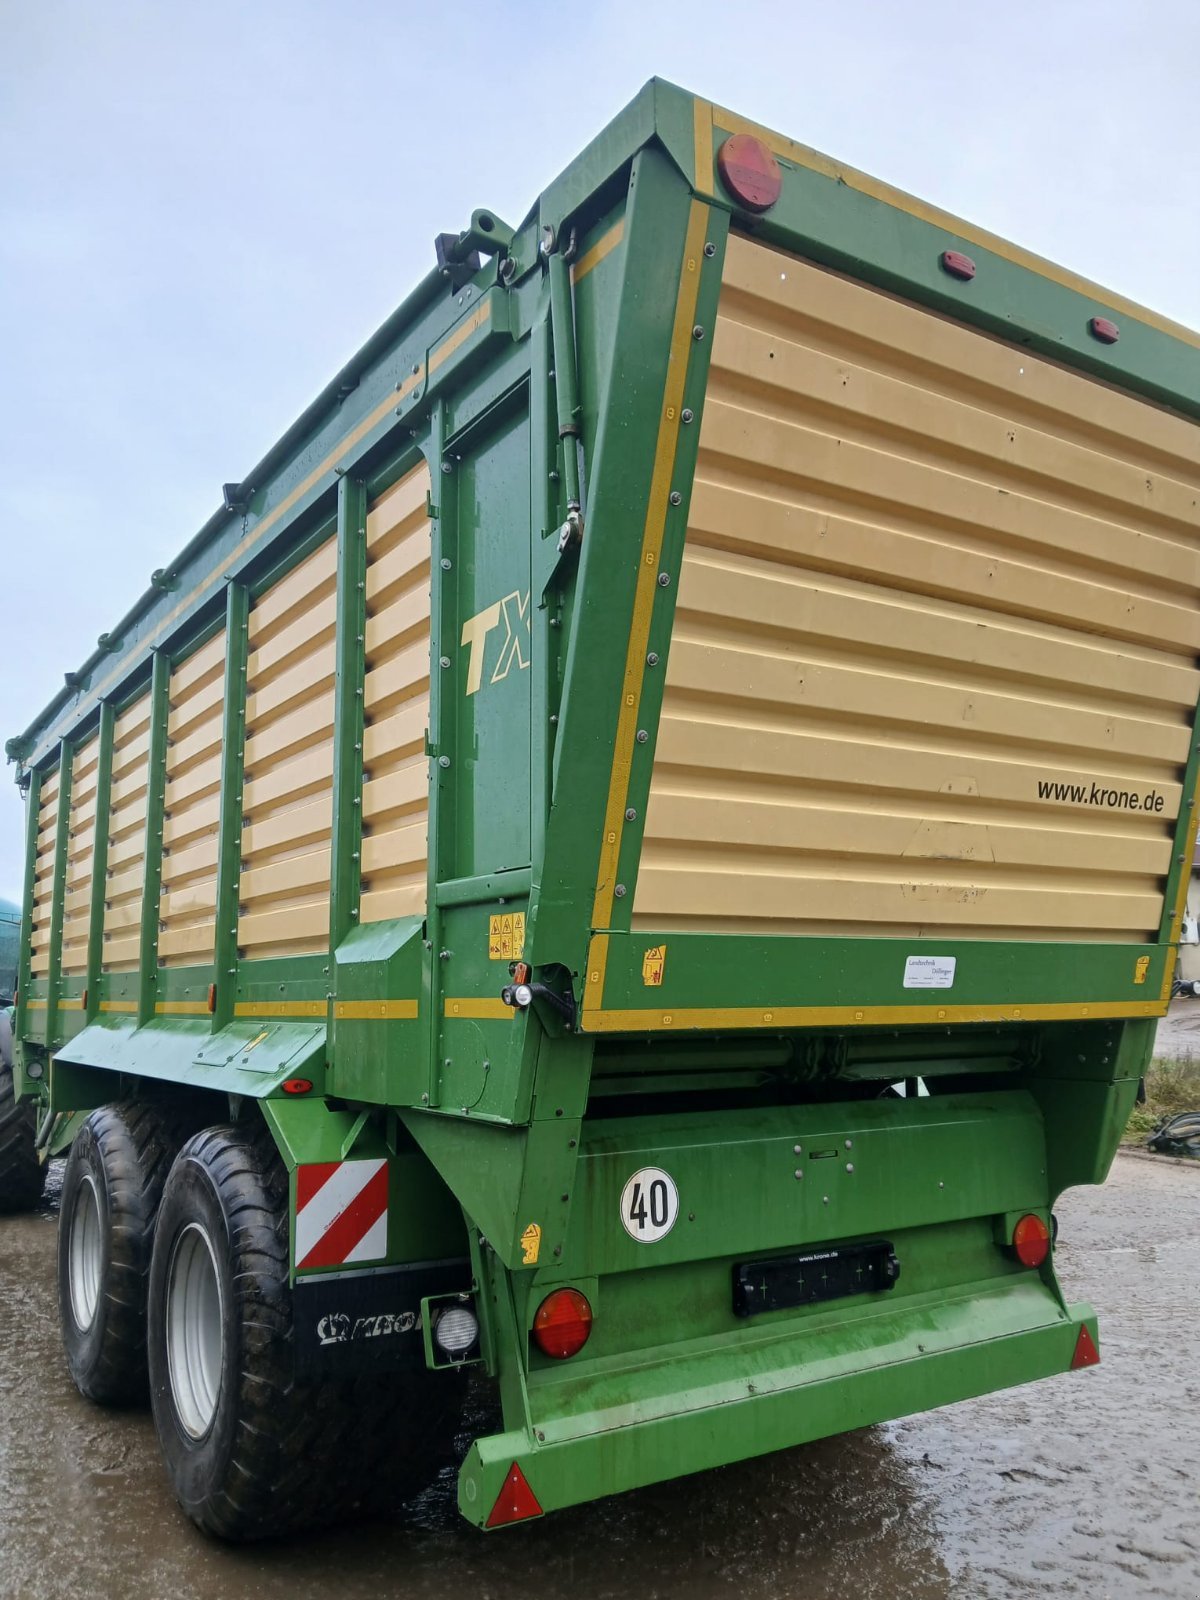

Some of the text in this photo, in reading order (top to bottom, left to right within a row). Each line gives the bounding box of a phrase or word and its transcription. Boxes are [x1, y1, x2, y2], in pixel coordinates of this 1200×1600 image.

[460, 589, 530, 696] TX
[1038, 781, 1164, 812] www.krone.de
[630, 1180, 668, 1229] 40
[799, 1251, 838, 1262] www.krone.de
